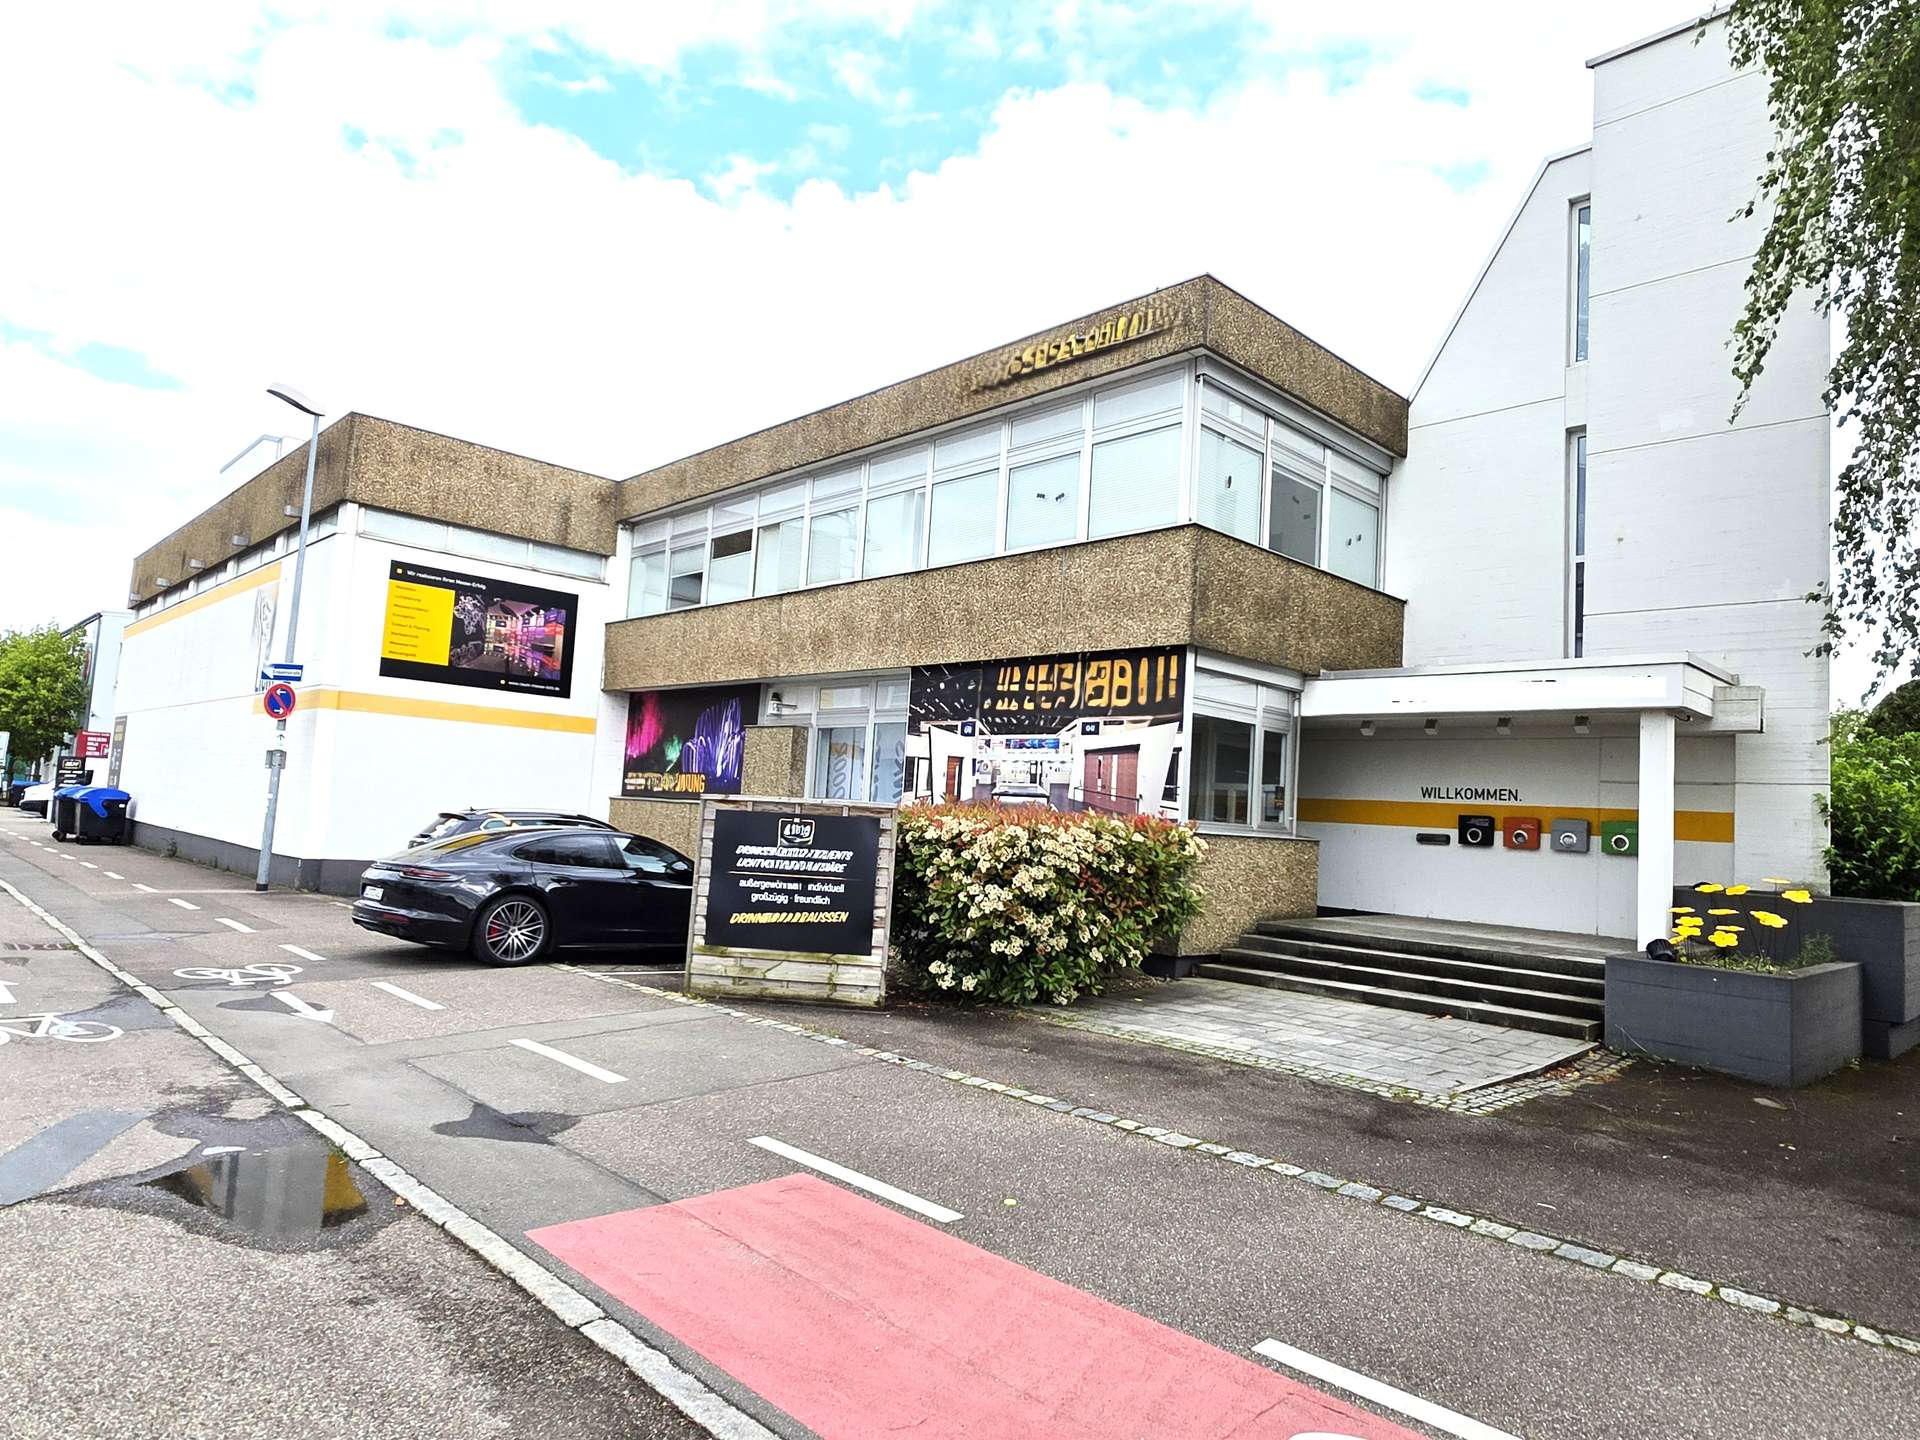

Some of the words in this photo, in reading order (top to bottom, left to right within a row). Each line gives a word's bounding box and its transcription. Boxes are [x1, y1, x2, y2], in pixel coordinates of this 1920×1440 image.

[1420, 786, 1522, 802] WILLKOMMEN.
[807, 883, 845, 893] individuell
[751, 892, 789, 904] großzügig
[794, 894, 831, 905] freundlich
